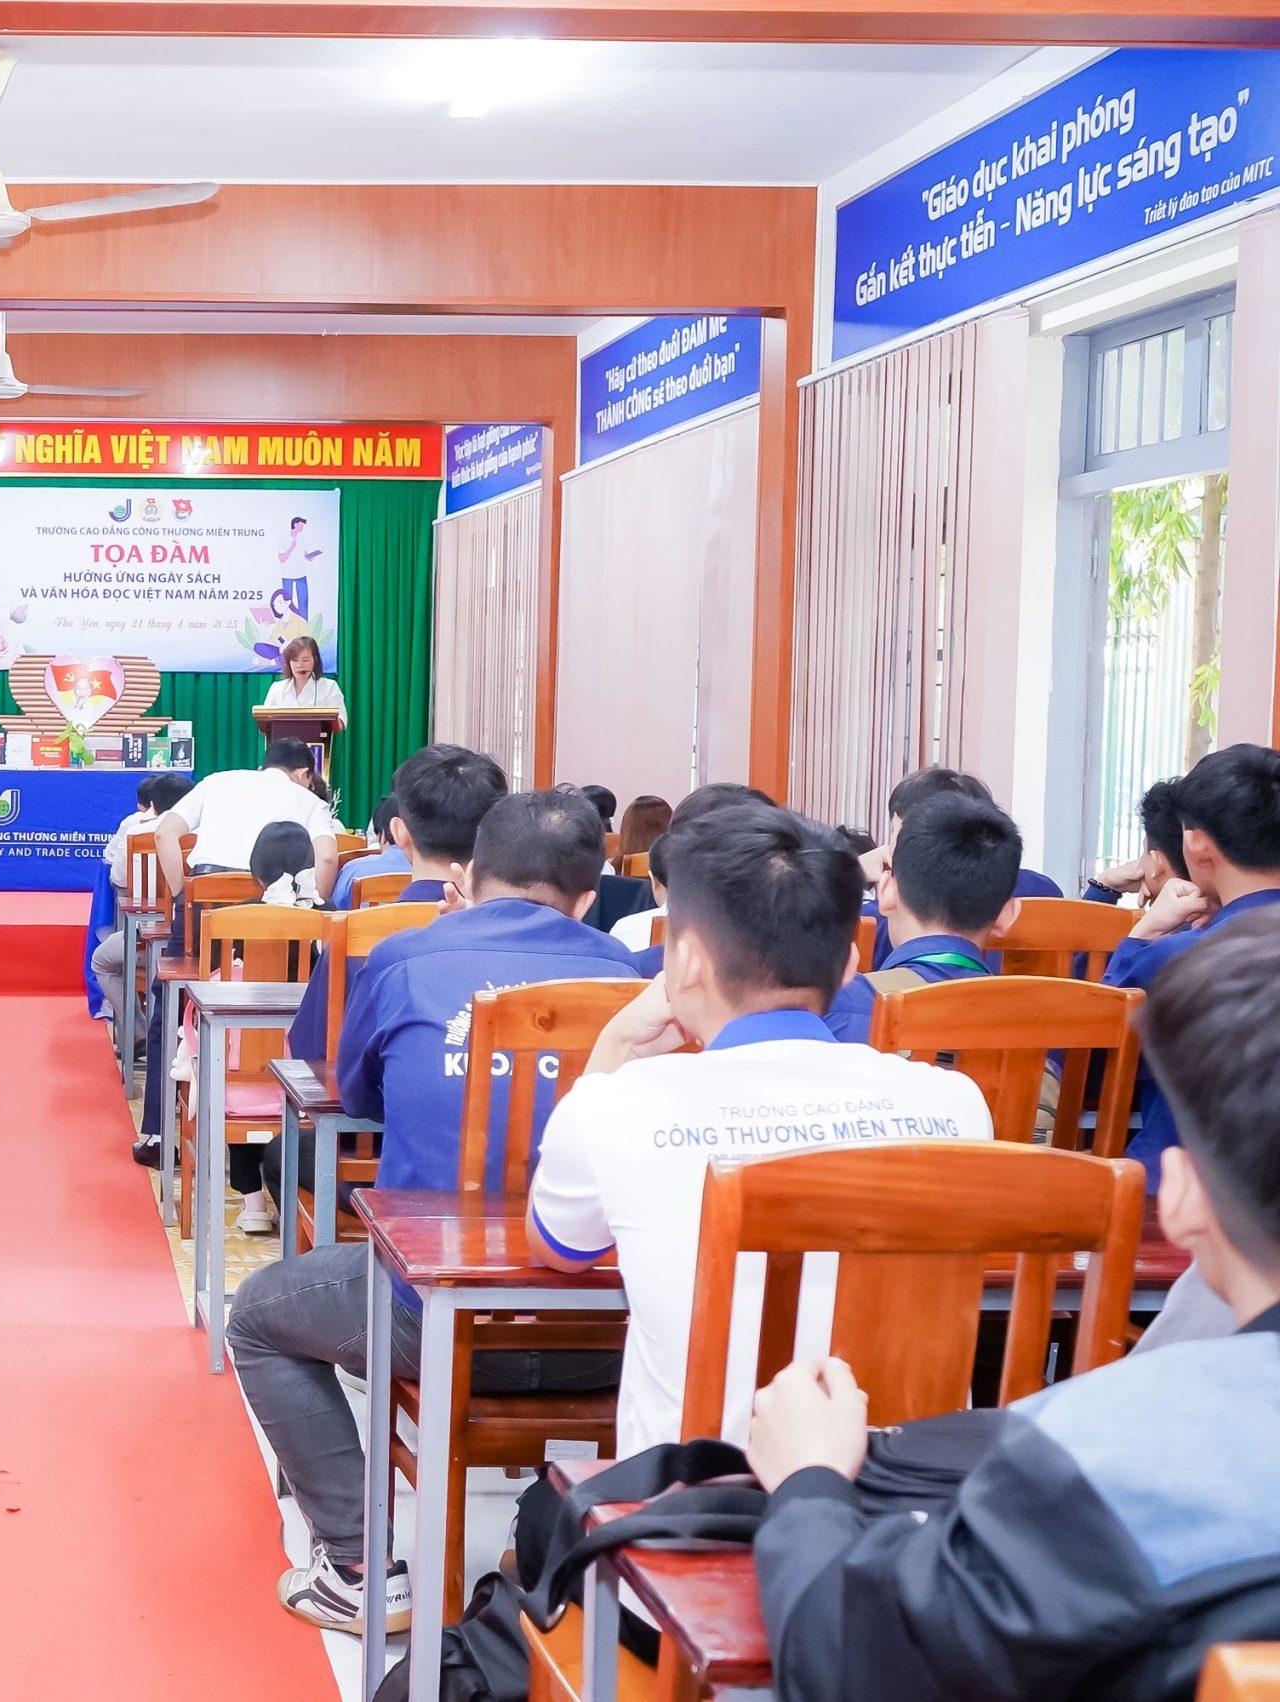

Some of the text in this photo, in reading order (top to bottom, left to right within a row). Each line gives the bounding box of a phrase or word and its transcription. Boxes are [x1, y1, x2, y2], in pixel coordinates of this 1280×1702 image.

[972, 154, 1008, 202] dục
[1011, 120, 1057, 178] khai
[1062, 88, 1137, 165] phóng
[1143, 156, 1275, 226] Triết lý đào tạo của MITC
[855, 261, 887, 307] Gắn
[889, 243, 916, 293] kết
[918, 235, 957, 280] thực
[960, 207, 996, 258] tiễn
[1015, 177, 1072, 236] Năng
[1077, 162, 1112, 213] lực
[1116, 129, 1182, 190] sáng
[638, 350, 658, 377] theo
[595, 400, 625, 434] THÀNH
[626, 386, 653, 420] CÔNG
[665, 374, 688, 402] theo
[15, 428, 102, 465] NGHĨA
[111, 428, 171, 470] VIỆT
[180, 434, 248, 467] NAM
[257, 430, 343, 467] MUÔN
[353, 432, 421, 468] NĂM
[90, 540, 211, 568] TỌA ĐÀM
[115, 569, 147, 584] ỨNG
[148, 570, 184, 584] NGÀY
[186, 570, 221, 585] SÁCH
[20, 585, 264, 603] VÀ VĂN HÓA ĐỌC VIỆT NAM NĂM 2025
[13, 831, 58, 842] THƯƠNG
[87, 833, 114, 843] TRUN
[8, 848, 32, 857] AND
[35, 848, 71, 858] TRADE
[653, 1122, 718, 1149] CÔNG
[726, 1123, 826, 1145] THƯƠNG
[891, 1116, 960, 1138] TRUNG
